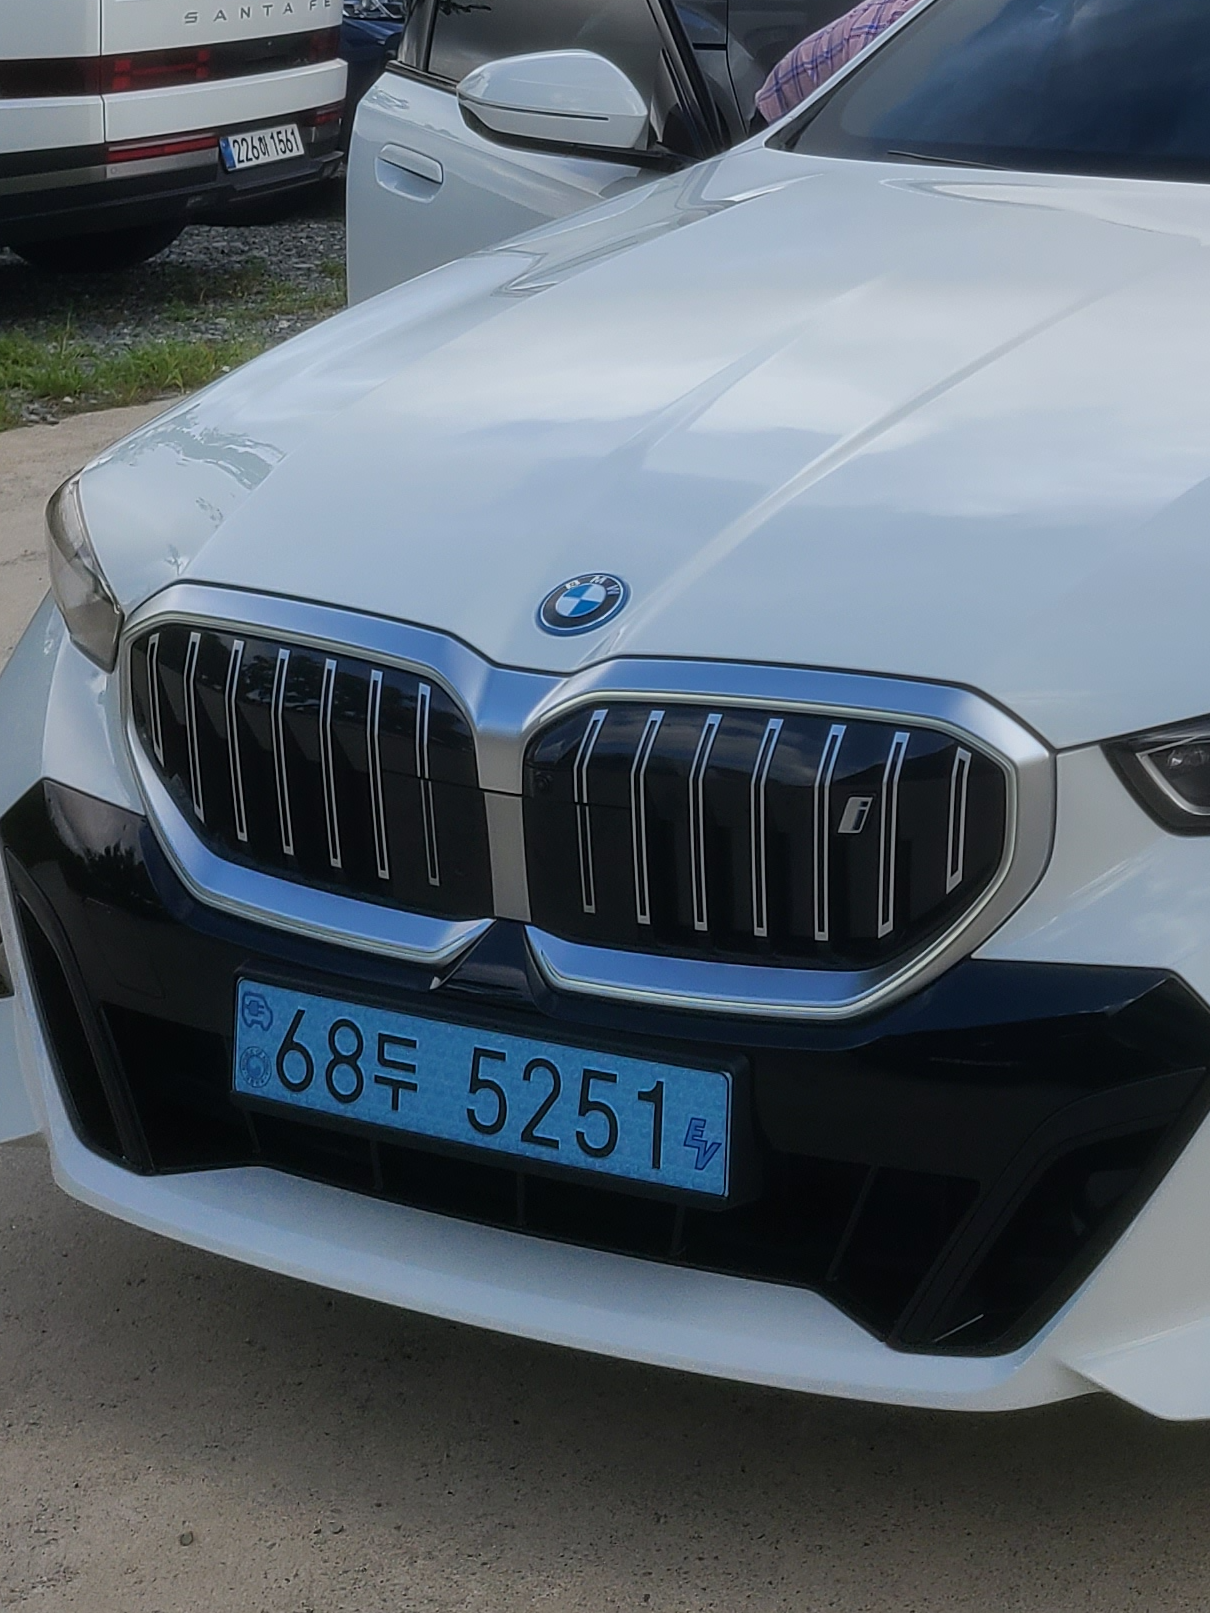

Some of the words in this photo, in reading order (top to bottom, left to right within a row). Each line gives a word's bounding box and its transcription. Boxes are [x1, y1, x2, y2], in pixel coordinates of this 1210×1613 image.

[184, 3, 293, 24] SANTA
[270, 128, 299, 156] 1561
[276, 1009, 418, 1111] 68두
[466, 1047, 664, 1169] 5251
[683, 1117, 721, 1171] EV
